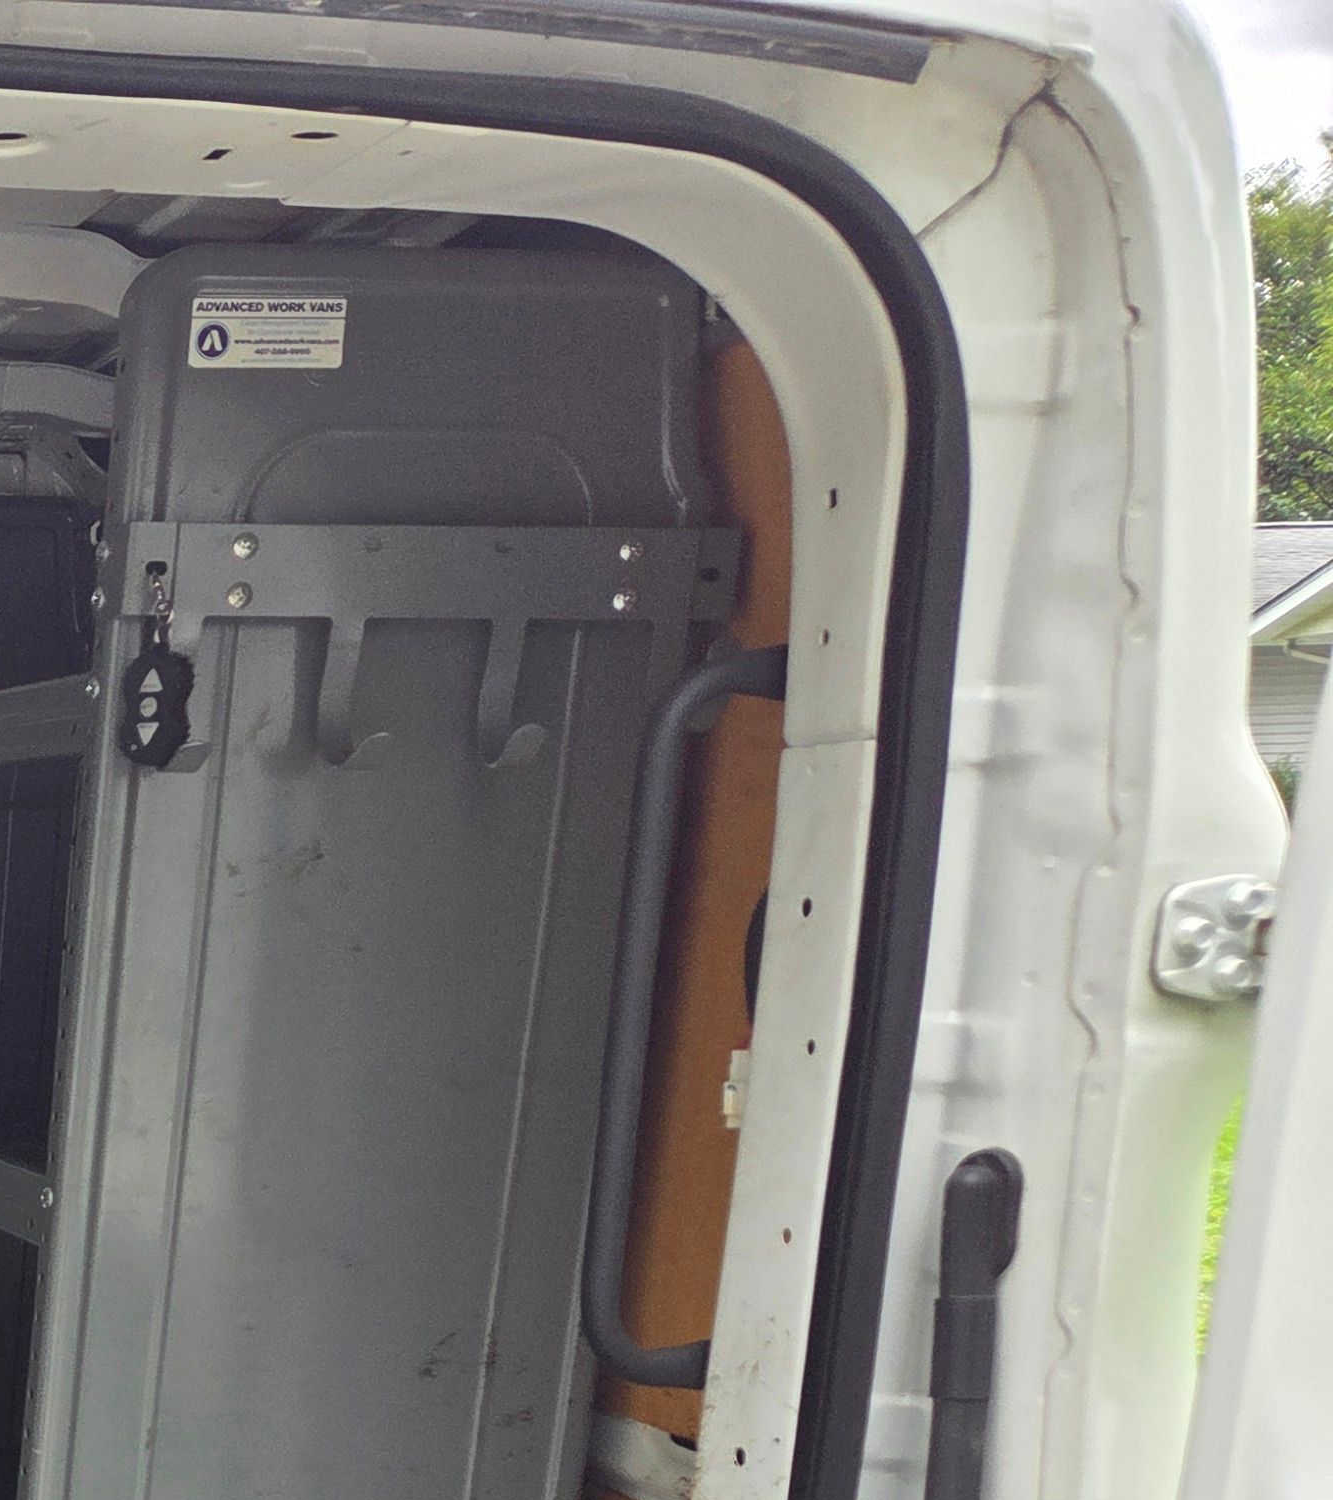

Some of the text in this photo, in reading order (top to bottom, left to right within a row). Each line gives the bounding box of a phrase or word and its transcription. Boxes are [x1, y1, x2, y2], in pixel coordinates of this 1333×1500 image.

[196, 301, 343, 313] ADVANCED WORK VANS
